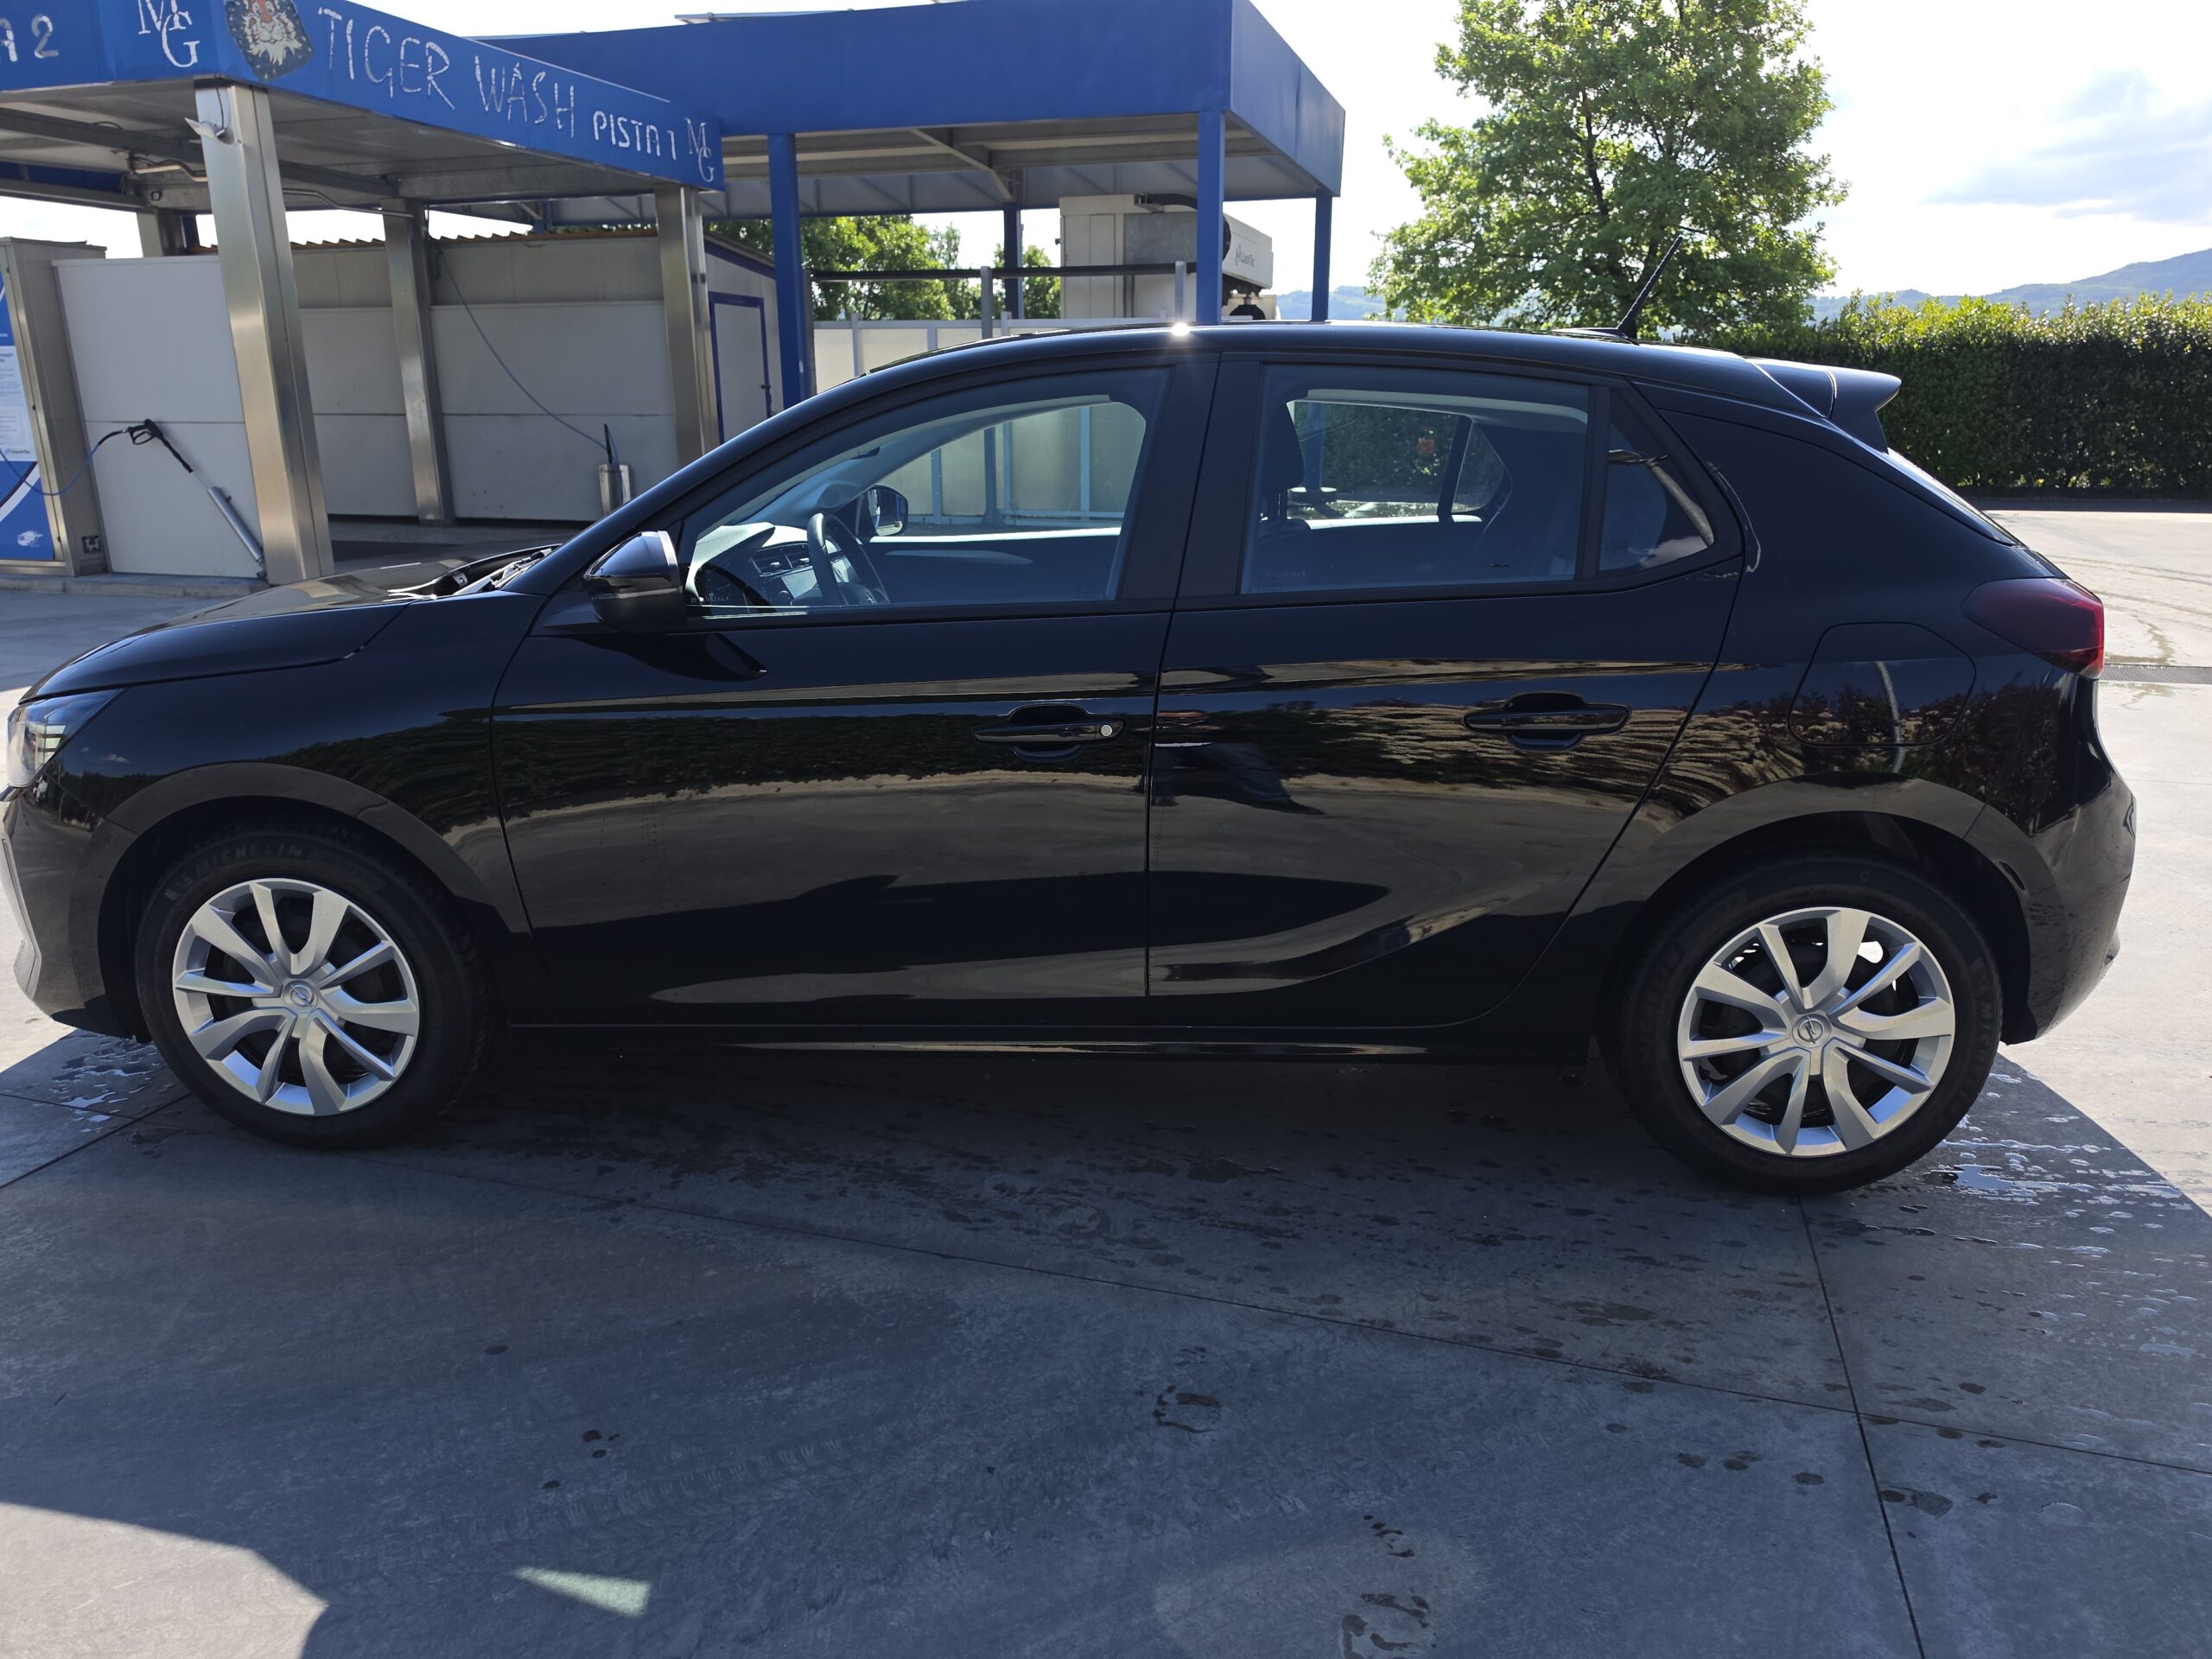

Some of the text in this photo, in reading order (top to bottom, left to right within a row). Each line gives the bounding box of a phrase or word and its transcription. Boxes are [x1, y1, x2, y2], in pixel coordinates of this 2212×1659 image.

[31, 14, 59, 59] 2
[318, 7, 677, 161] TIGER WASH PISTA 1
